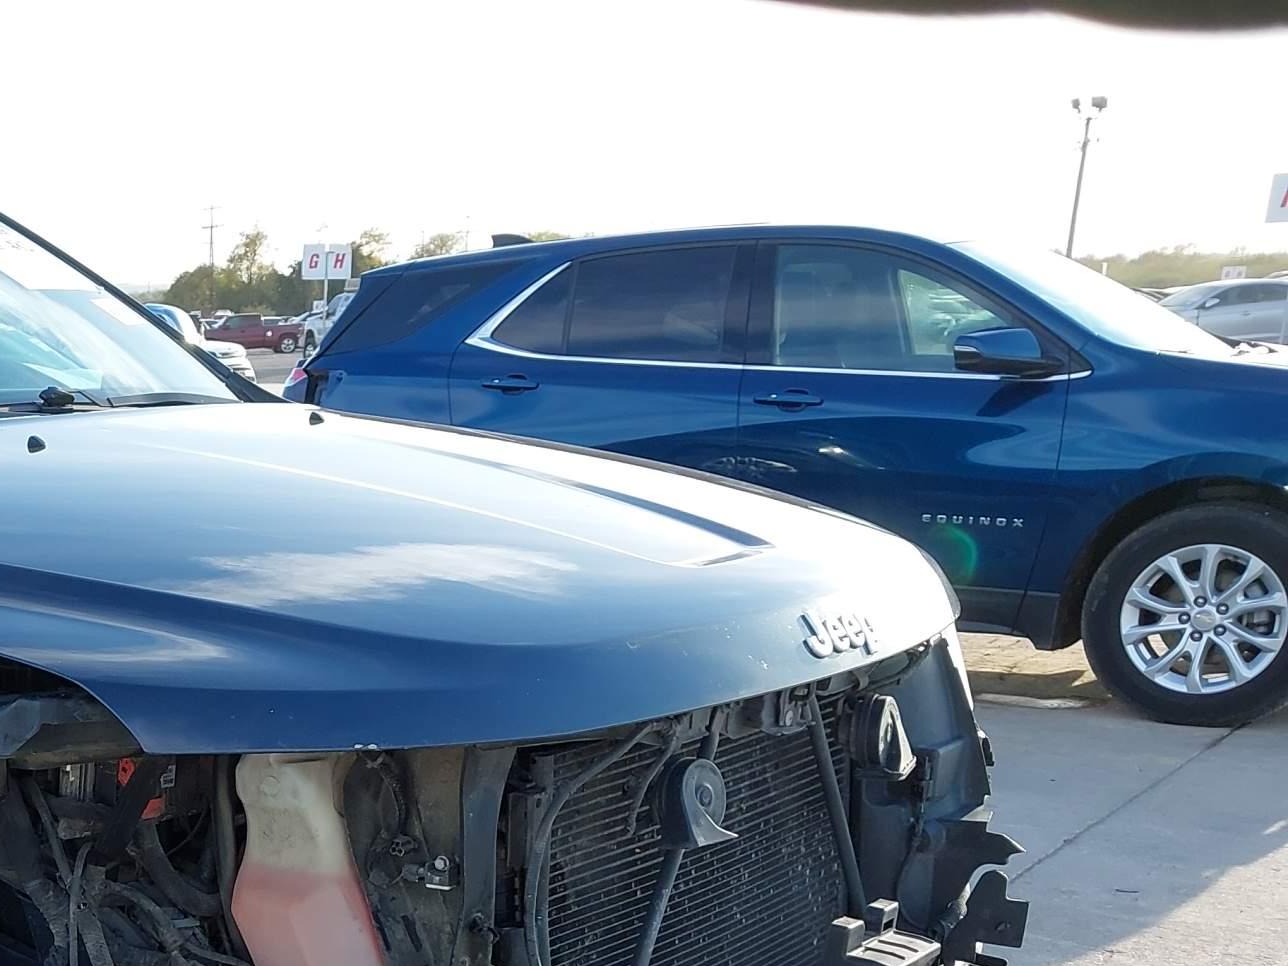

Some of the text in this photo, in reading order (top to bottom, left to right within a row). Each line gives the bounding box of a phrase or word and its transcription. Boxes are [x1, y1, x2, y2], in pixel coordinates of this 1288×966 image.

[309, 253, 346, 269] G H
[921, 513, 1024, 528] EQUINOX
[797, 610, 879, 659] Jeep
